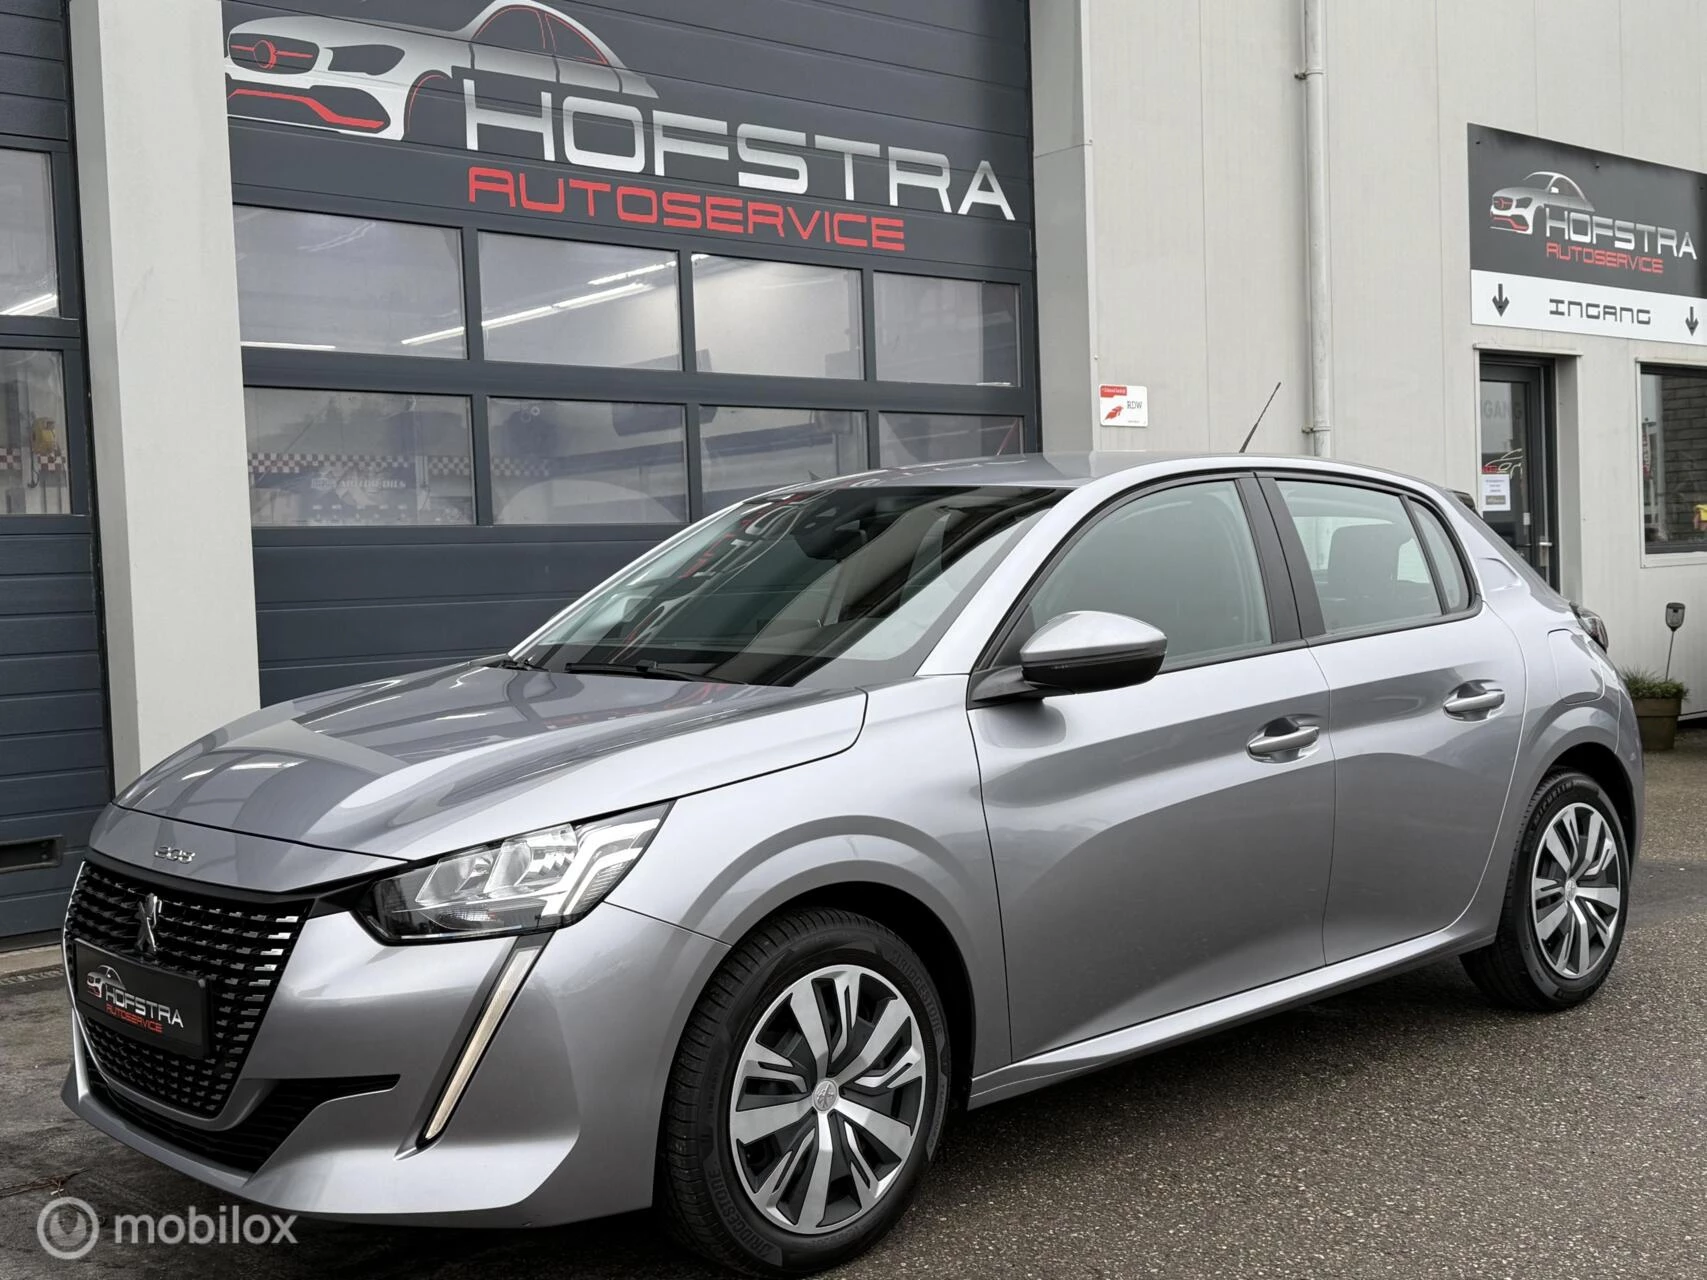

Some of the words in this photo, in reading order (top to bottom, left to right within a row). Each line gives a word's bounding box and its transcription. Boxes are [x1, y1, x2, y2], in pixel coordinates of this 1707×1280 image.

[462, 78, 1016, 221] HOFSTRA
[468, 166, 906, 251] AUTOSERVICE
[1545, 208, 1697, 260] HOFSTRA
[1546, 242, 1664, 274] AUTOSERVICE
[1549, 298, 1651, 325] INGANG
[104, 984, 184, 1028] HOFSTRA
[105, 1003, 164, 1033] AUTOSERVICE
